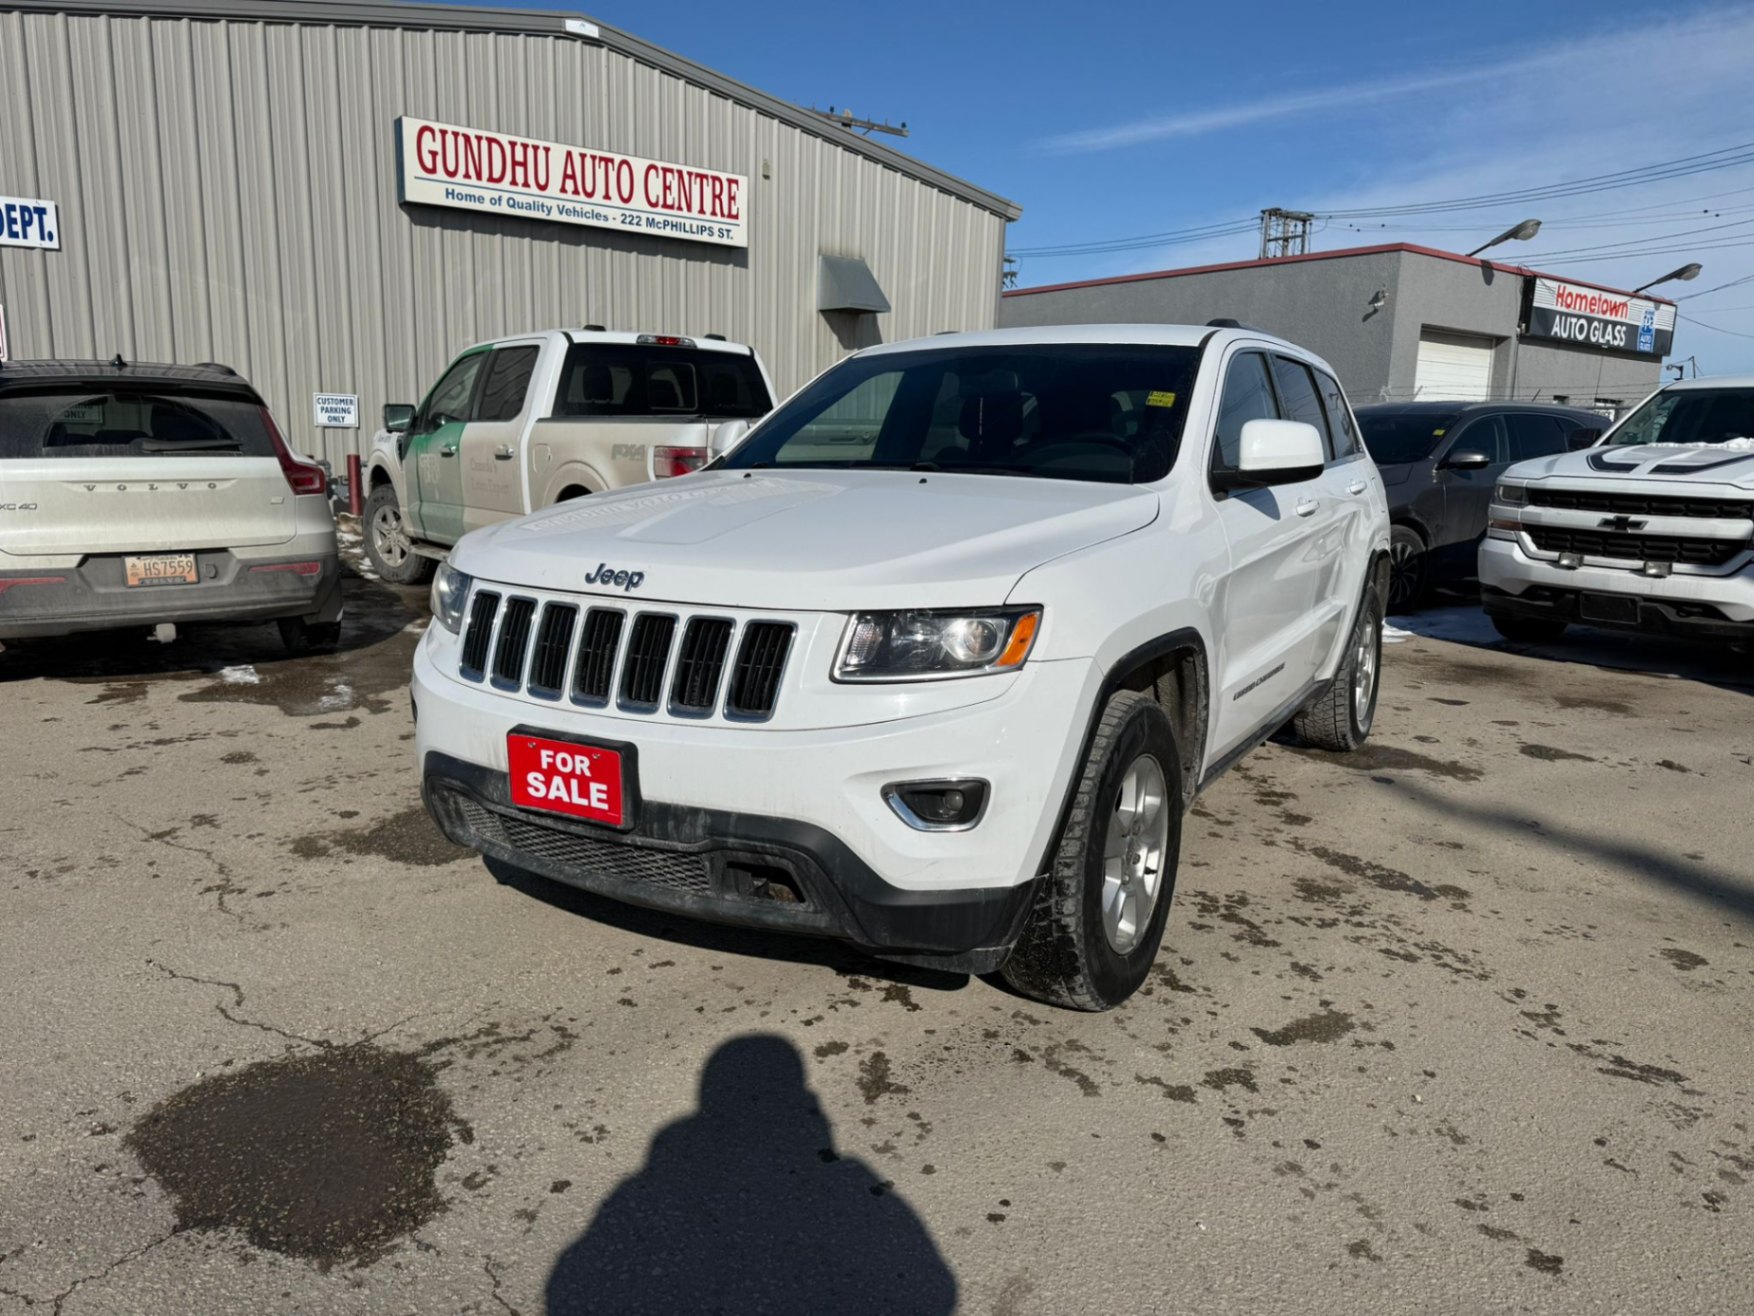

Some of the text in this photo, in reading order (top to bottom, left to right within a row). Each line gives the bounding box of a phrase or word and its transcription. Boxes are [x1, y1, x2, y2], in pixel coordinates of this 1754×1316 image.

[416, 125, 740, 220] GUNDHU AUTO CENTRE
[445, 187, 485, 204] Home
[489, 195, 502, 206] of
[506, 197, 553, 216] Quality
[556, 204, 609, 222] Vehicles
[620, 213, 642, 227] 222
[645, 217, 715, 237] McPHILLIPS
[717, 227, 734, 240] ST.
[1555, 284, 1629, 319] Hometown
[1551, 315, 1627, 347] AUTO GLASS
[317, 397, 354, 406] CUSTOMER
[320, 406, 351, 415] PARKING
[327, 415, 345, 423] ONLY
[611, 443, 646, 461] FX4
[83, 482, 217, 492] VOLVO
[143, 560, 193, 577] HS7559
[585, 563, 645, 592] Jeep
[540, 749, 592, 777] FOR
[526, 772, 609, 810] SALE
